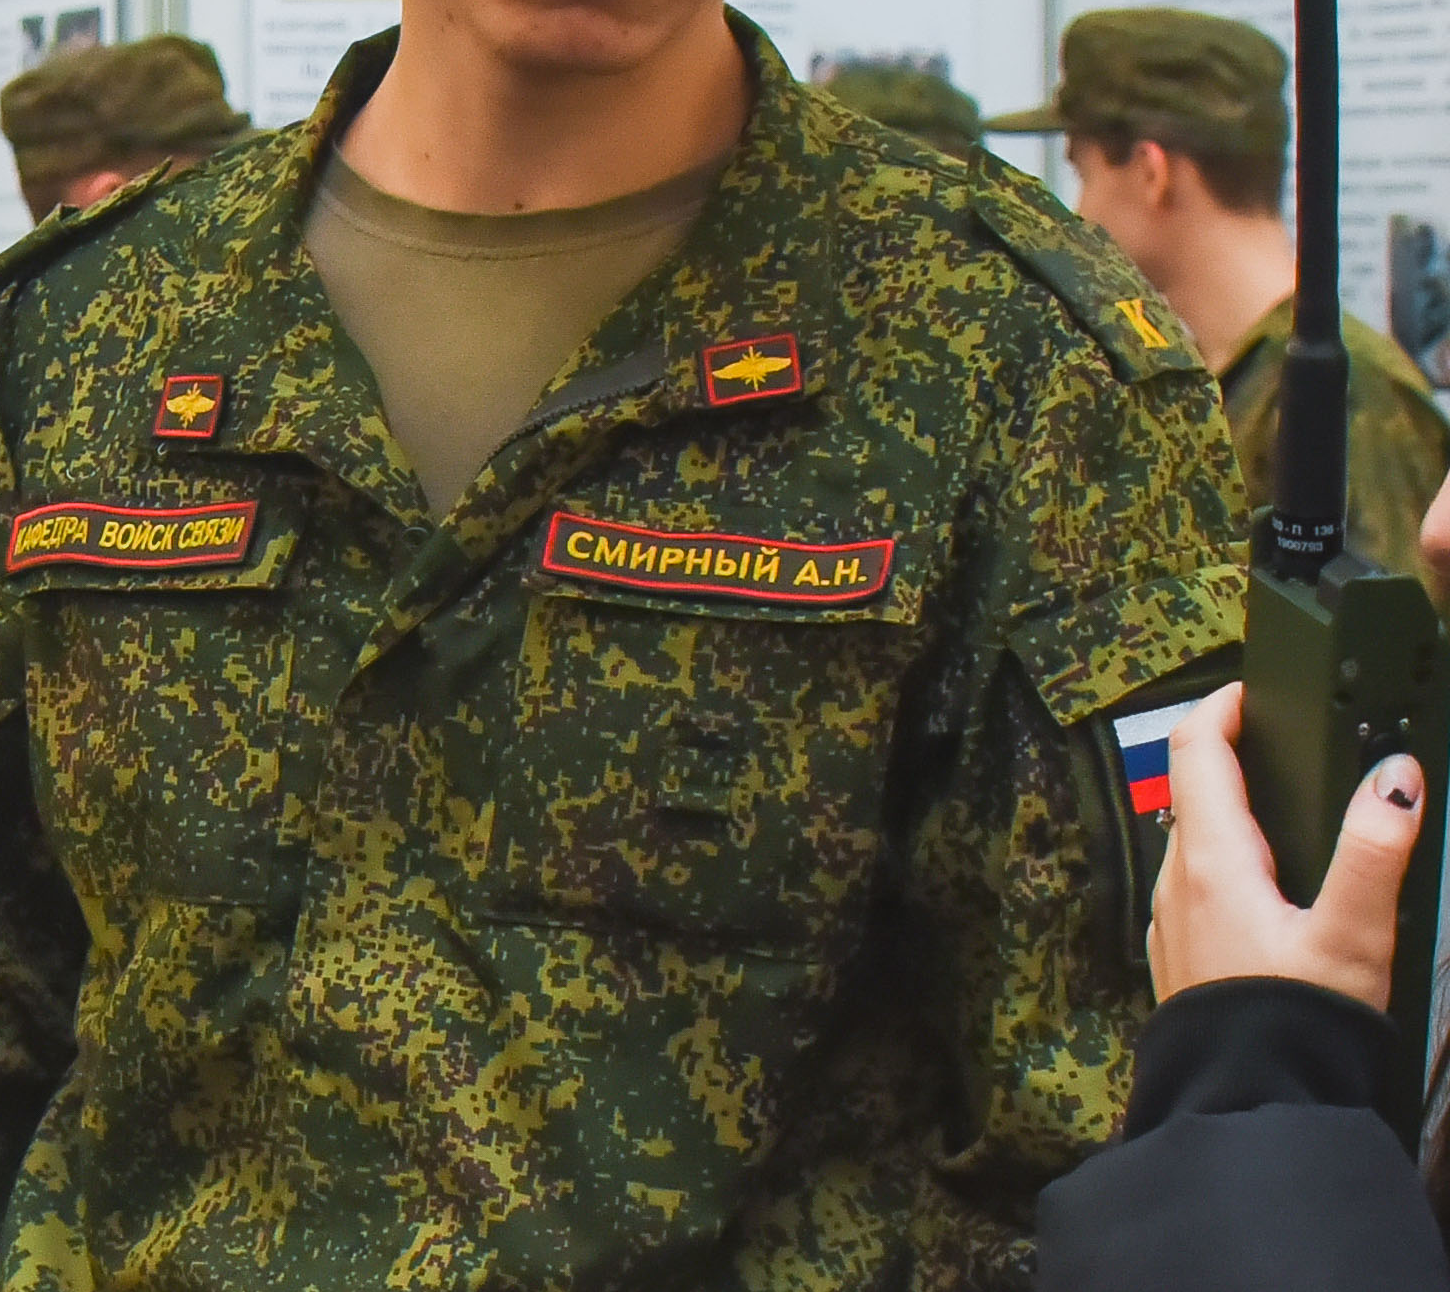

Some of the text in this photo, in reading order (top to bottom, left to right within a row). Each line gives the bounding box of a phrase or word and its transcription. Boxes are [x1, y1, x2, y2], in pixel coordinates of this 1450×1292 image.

[13, 516, 246, 556] КАФЕДРА ВОЙСК СВЯЗИ
[567, 531, 868, 587] СМИРНЫЙ А.Н.
